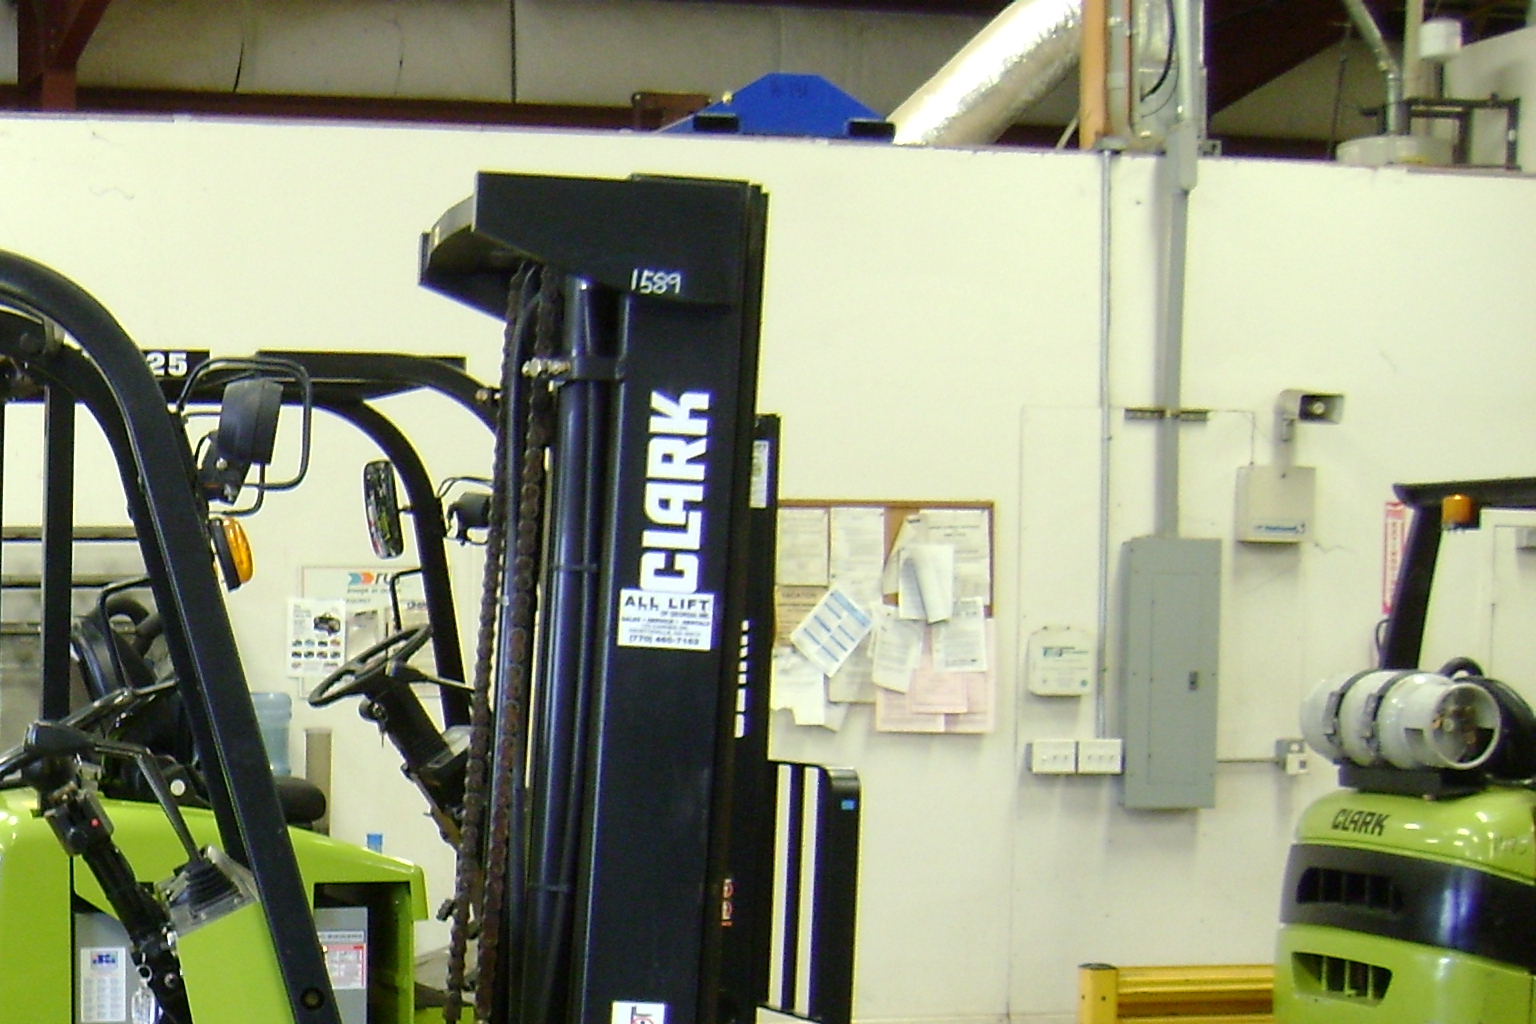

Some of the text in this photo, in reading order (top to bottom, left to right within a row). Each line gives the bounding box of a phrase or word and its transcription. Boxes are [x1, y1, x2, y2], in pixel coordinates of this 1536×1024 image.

[631, 269, 682, 295] 1589
[147, 352, 189, 377] 25
[640, 390, 710, 592] CLARK
[624, 596, 710, 612] ALL LIFT
[1331, 808, 1390, 837] CLARK
